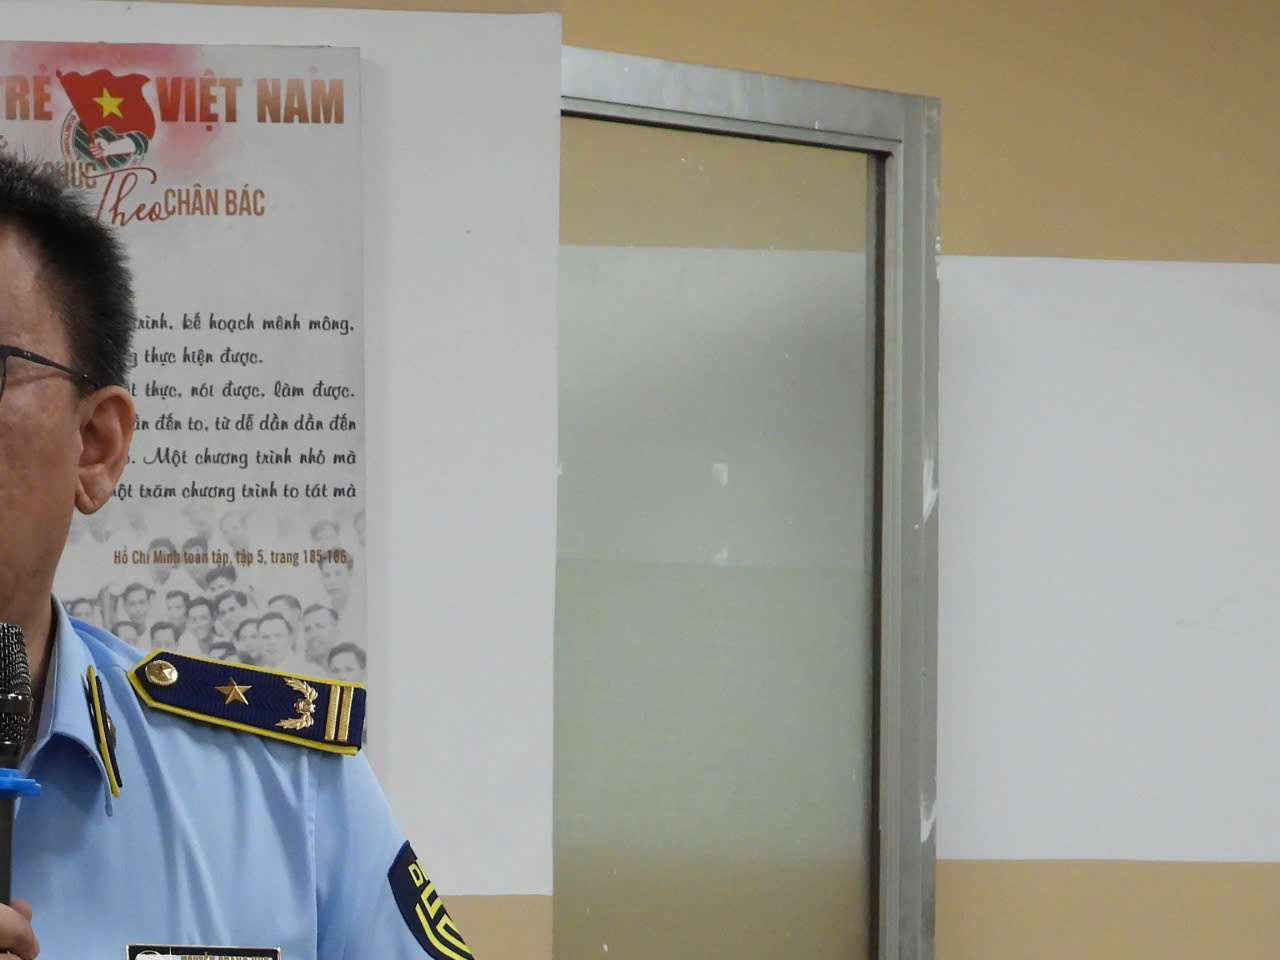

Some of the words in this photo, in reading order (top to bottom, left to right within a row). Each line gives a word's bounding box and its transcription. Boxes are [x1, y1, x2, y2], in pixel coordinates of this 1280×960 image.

[156, 69, 244, 132] VIỆT
[257, 78, 345, 125] NAM
[81, 167, 171, 227] Theo
[164, 183, 219, 216] CHÂN
[225, 183, 265, 217] BÁC
[182, 312, 201, 331] kế
[209, 312, 255, 333] hoạch
[262, 313, 301, 331] mênh
[144, 346, 177, 367] thực
[182, 346, 214, 367] hiện
[220, 346, 263, 367] được.
[191, 382, 215, 398] nói
[274, 380, 305, 398] làm
[312, 380, 356, 401] được.
[155, 412, 182, 431] đến
[215, 415, 231, 431] từ
[235, 413, 255, 431] dễ
[259, 412, 289, 431] dần
[294, 412, 324, 431] dần
[329, 412, 357, 431] đến
[143, 447, 188, 468] Một
[195, 447, 249, 469] chương
[256, 447, 292, 465] trình
[300, 447, 326, 465] nhỏ
[333, 449, 357, 465] mà
[140, 484, 177, 498] trăm
[182, 480, 236, 503] chương
[242, 480, 278, 498] trình
[283, 483, 300, 498] to
[305, 483, 329, 498] tát
[333, 483, 357, 498] mà
[153, 549, 180, 565] Minh
[270, 550, 300, 568] trang
